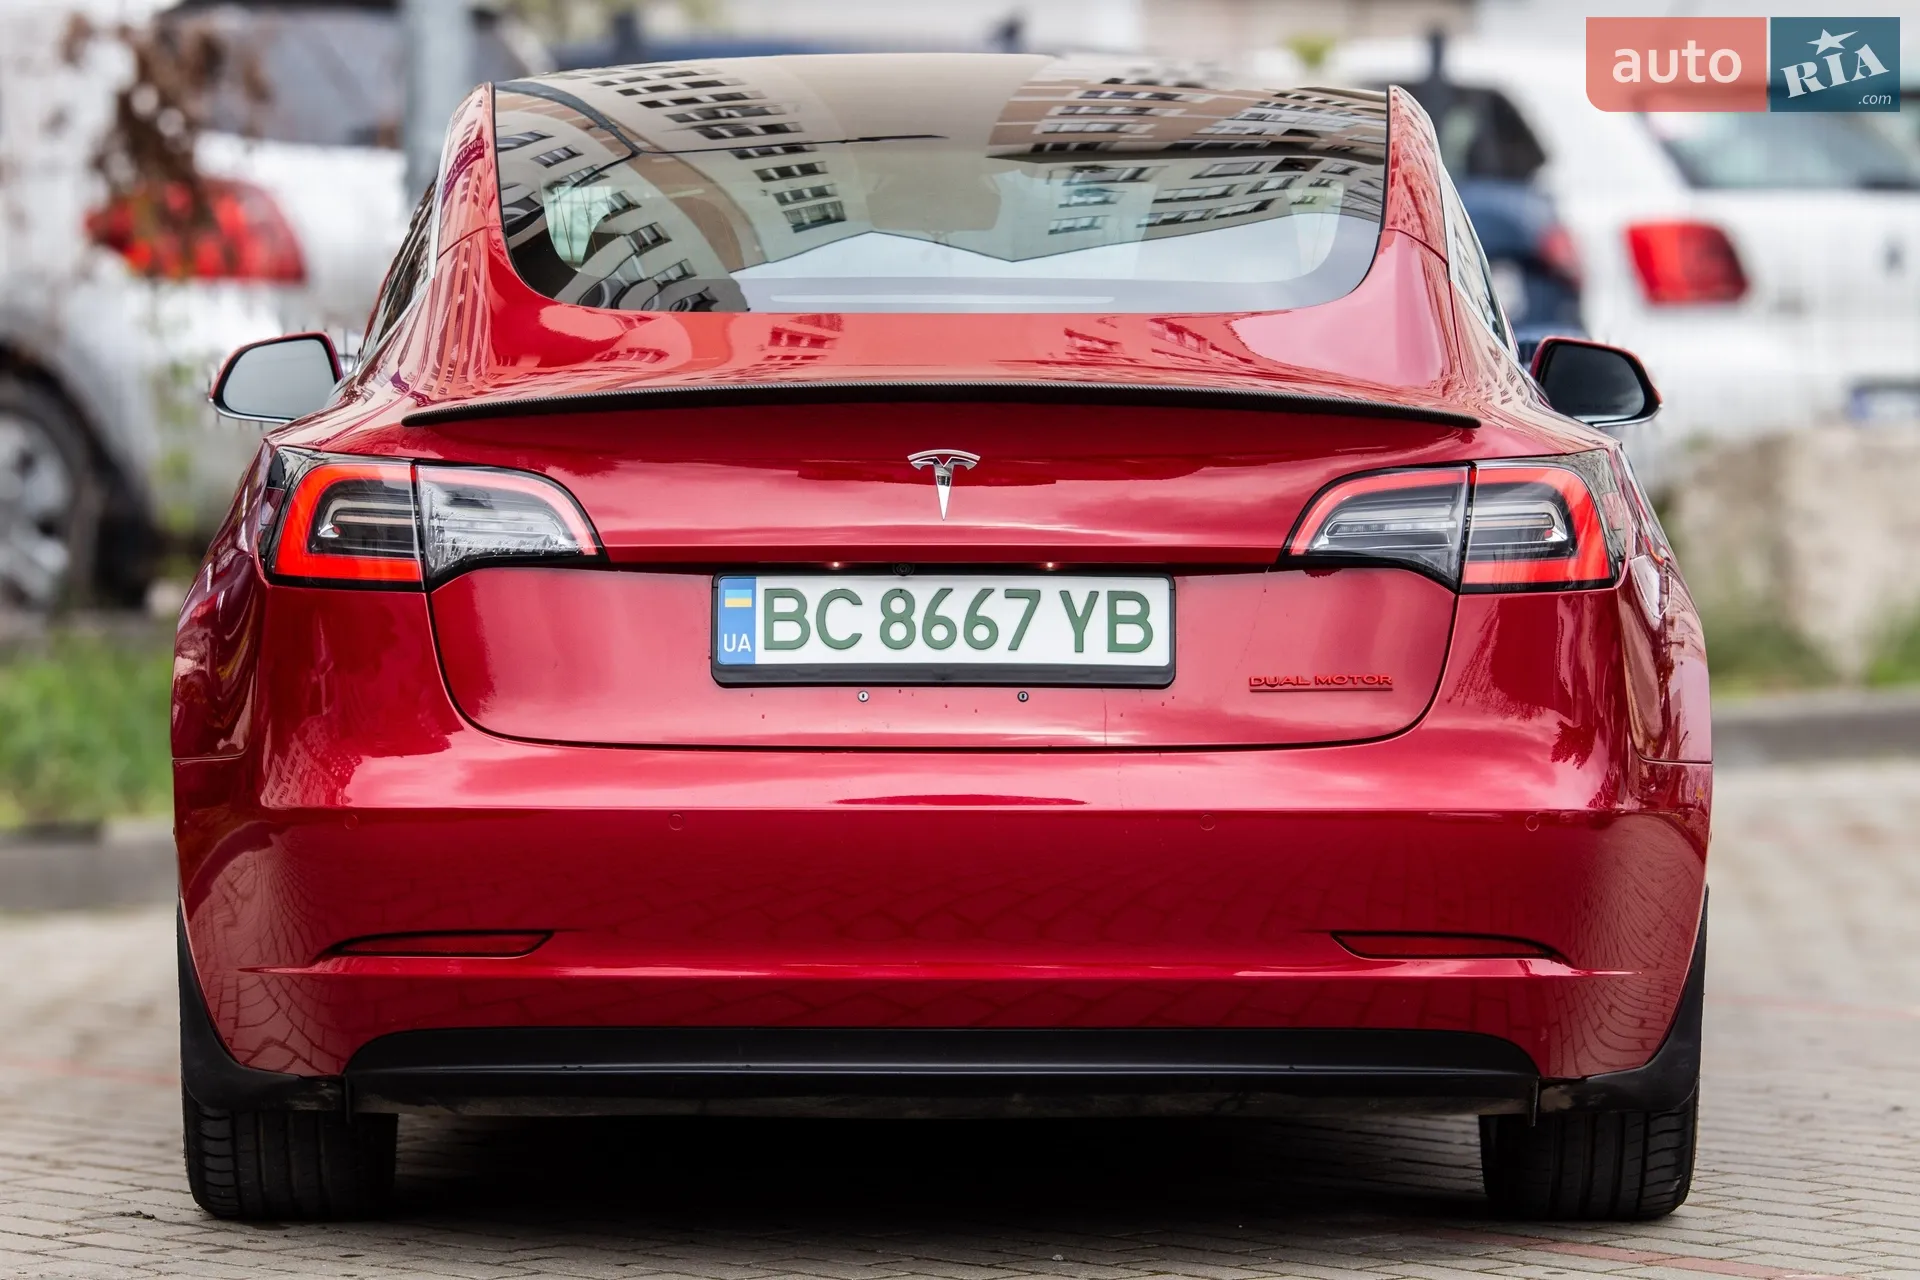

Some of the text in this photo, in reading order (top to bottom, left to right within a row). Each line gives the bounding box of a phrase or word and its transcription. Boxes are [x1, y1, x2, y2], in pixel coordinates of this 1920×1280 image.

[764, 588, 1154, 654] BC 8667 YB
[723, 633, 752, 653] UA
[1250, 674, 1393, 687] DUAL MOTOR
